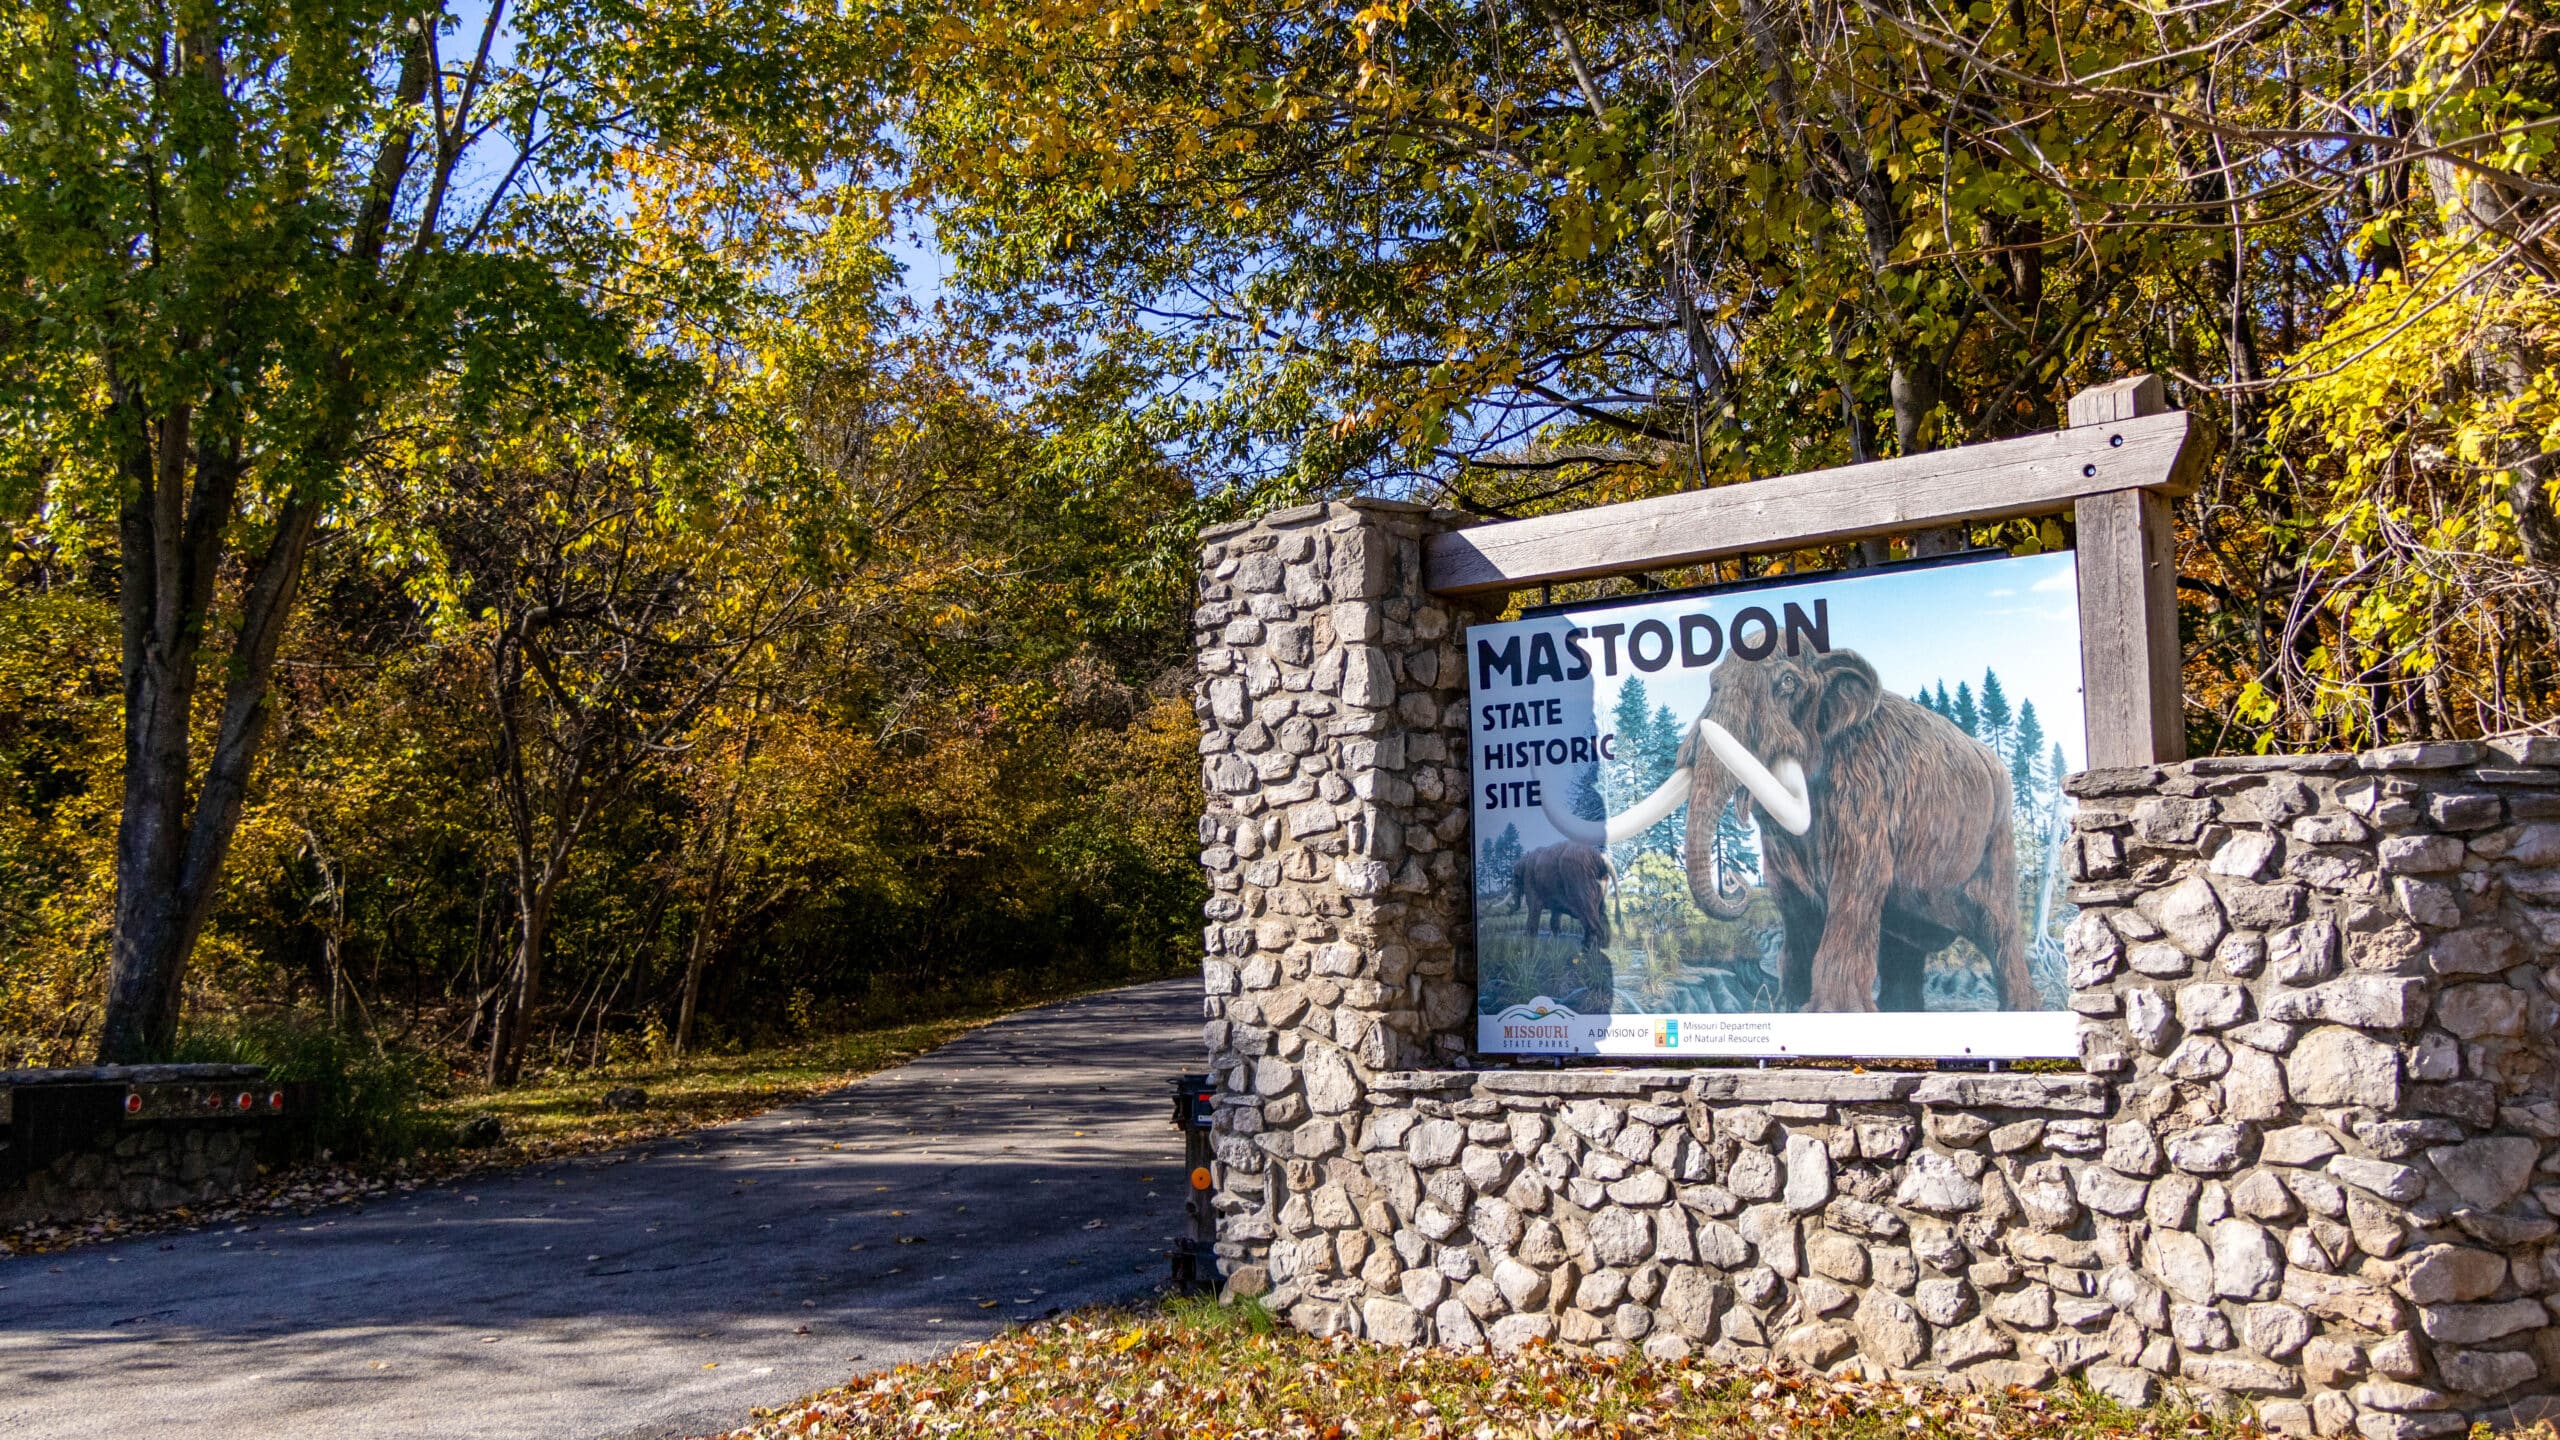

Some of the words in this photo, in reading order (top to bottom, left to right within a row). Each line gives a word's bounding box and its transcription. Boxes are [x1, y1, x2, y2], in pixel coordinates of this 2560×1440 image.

[1477, 598, 1831, 690] MASTODON
[1482, 698, 1562, 731] STATE
[1484, 734, 1615, 770] HISTORIC
[1485, 780, 1542, 810] SITE
[1504, 1025, 1568, 1039] MISSOURI
[1588, 1028, 1596, 1038] A
[1597, 1028, 1635, 1038] DIVISION
[1638, 1028, 1649, 1038] OF
[1683, 1021, 1717, 1030] Missouri
[1720, 1021, 1771, 1032] Department
[1503, 1040, 1531, 1048] STATE
[1539, 1040, 1569, 1048] PARKS
[1683, 1034, 1692, 1043] of
[1695, 1034, 1726, 1043] Natural
[1728, 1034, 1770, 1043] Resources
